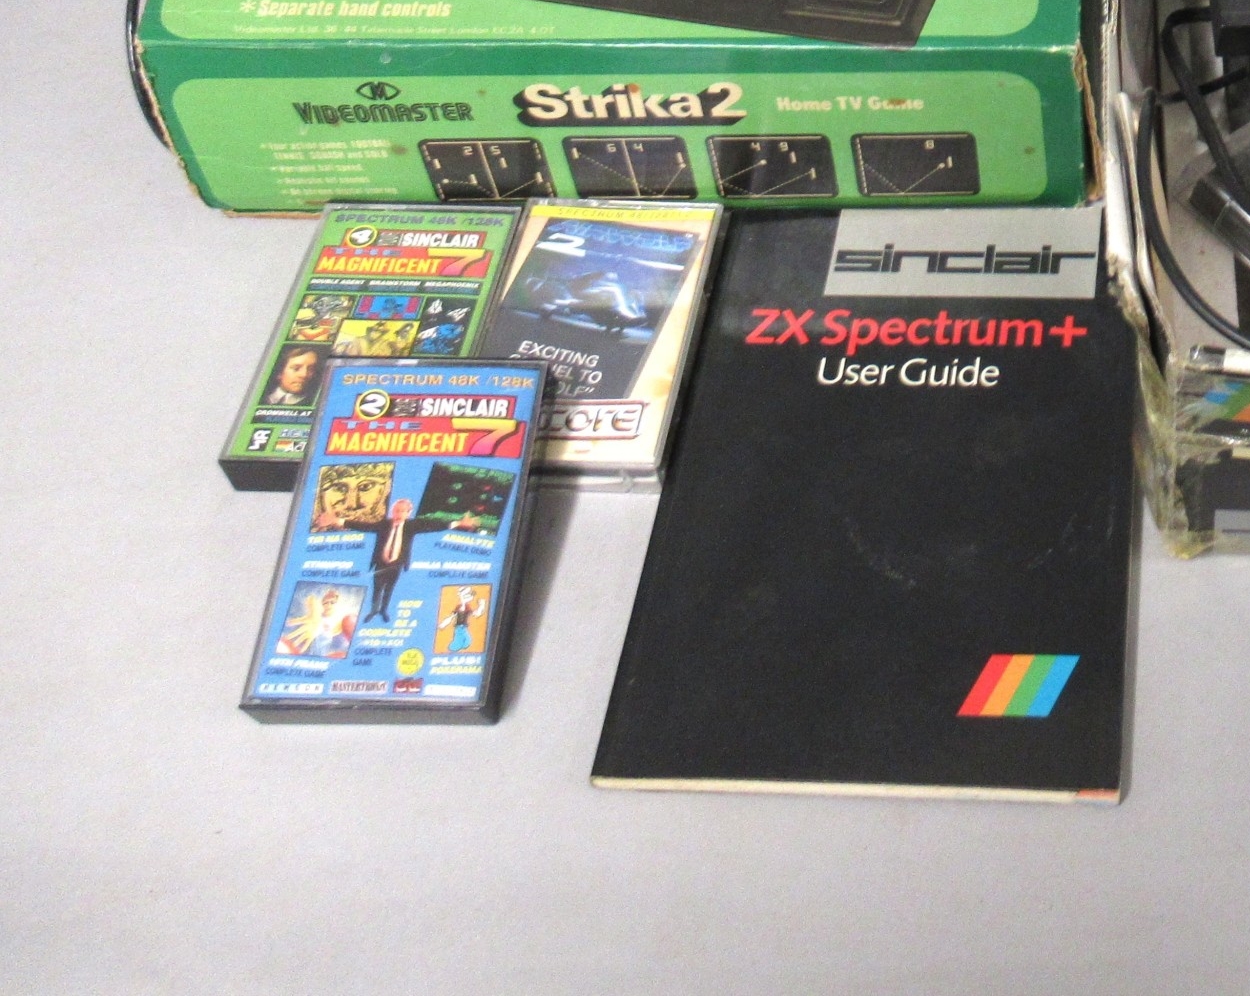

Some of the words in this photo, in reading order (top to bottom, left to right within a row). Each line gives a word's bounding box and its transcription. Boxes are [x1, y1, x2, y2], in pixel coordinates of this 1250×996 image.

[256, 0, 334, 18] Separate
[339, 1, 380, 17] hand
[382, 1, 452, 18] controls
[292, 102, 474, 123] VIDEOMASTER
[776, 96, 832, 112] Home
[835, 96, 863, 111] TV
[335, 214, 426, 225] SPECTRUM
[351, 229, 372, 245] 4
[401, 232, 480, 247] SINCLAIR
[536, 231, 586, 258] 2
[317, 256, 443, 274] MAGNIFICENT
[427, 248, 485, 276] 7
[834, 243, 1096, 275] sinclair
[745, 308, 815, 345] ZX
[518, 340, 600, 367] EXCITING
[343, 374, 443, 386] SPECTRUM
[580, 369, 603, 384] TO
[817, 357, 895, 386] User
[900, 357, 1000, 387] Guide
[359, 393, 389, 413] 2
[421, 397, 509, 417] SINCLAIR
[328, 432, 470, 453] MAGNIFICENT
[451, 418, 517, 457] 7
